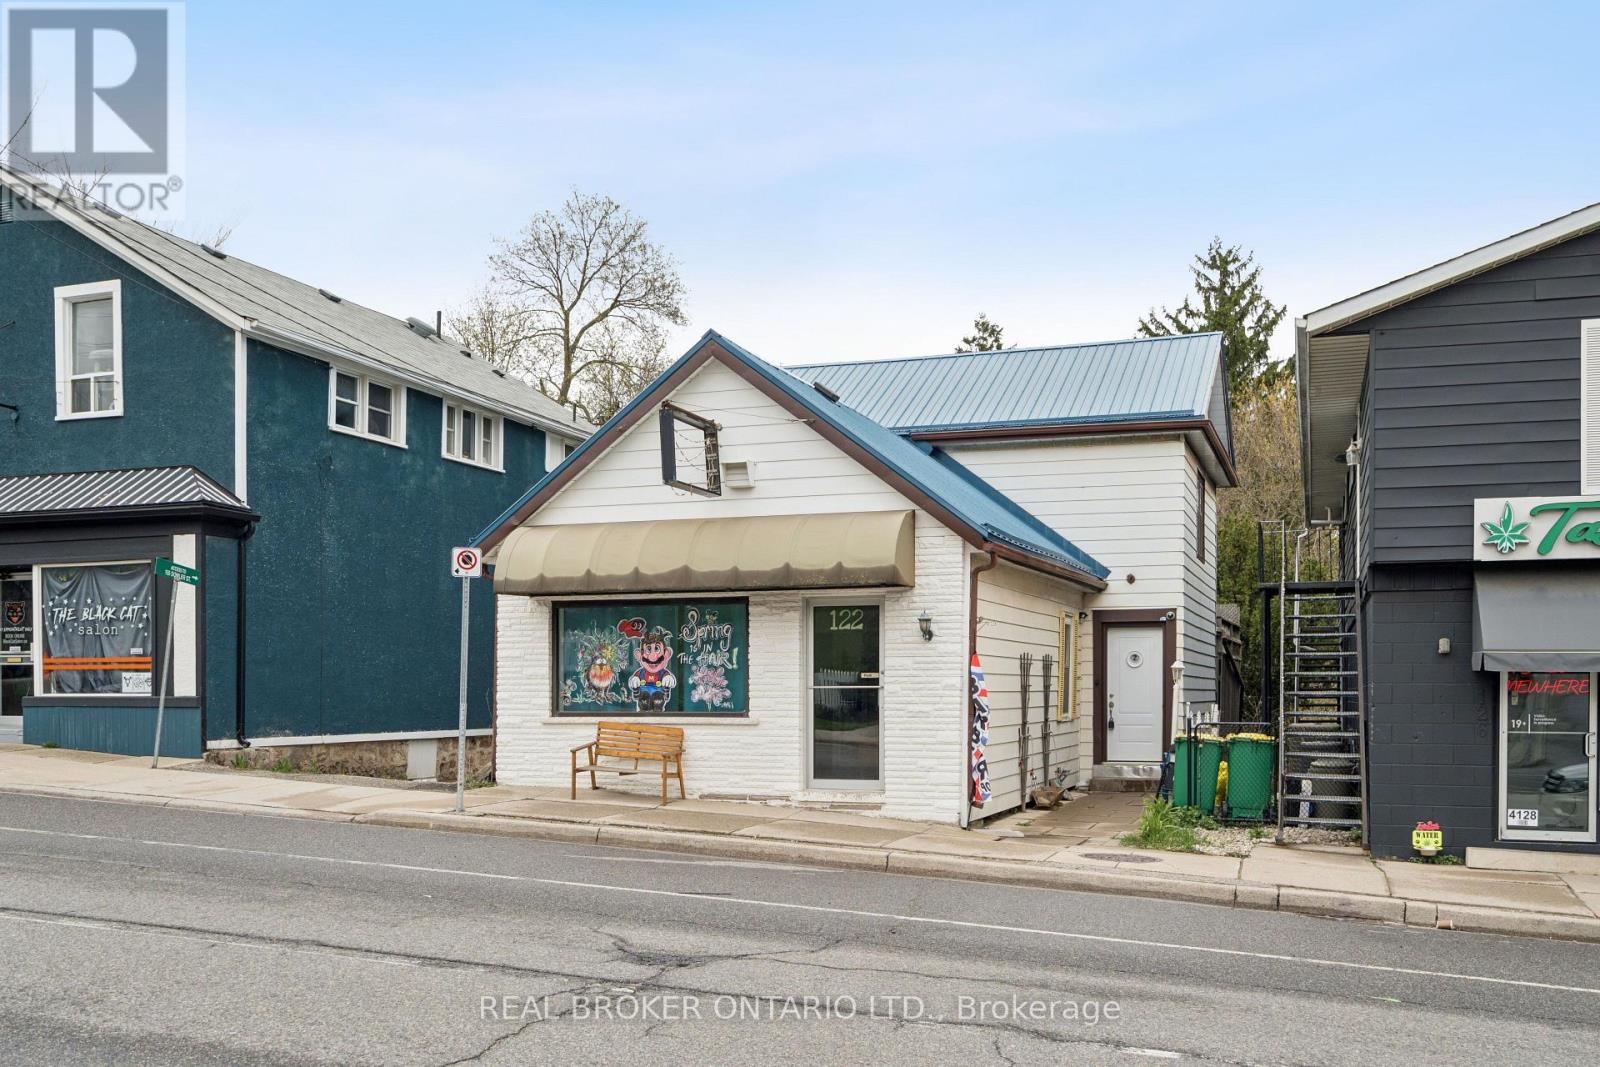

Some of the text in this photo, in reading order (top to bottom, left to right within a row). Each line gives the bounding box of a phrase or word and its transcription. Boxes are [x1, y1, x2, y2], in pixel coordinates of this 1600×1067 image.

[1529, 501, 1600, 556] Ta
[53, 605, 142, 624] THE BLACK CAT
[830, 609, 864, 630] 122
[79, 624, 119, 635] salon
[678, 607, 732, 651] Spring
[677, 653, 694, 664] THE
[1509, 810, 1536, 820] 4128
